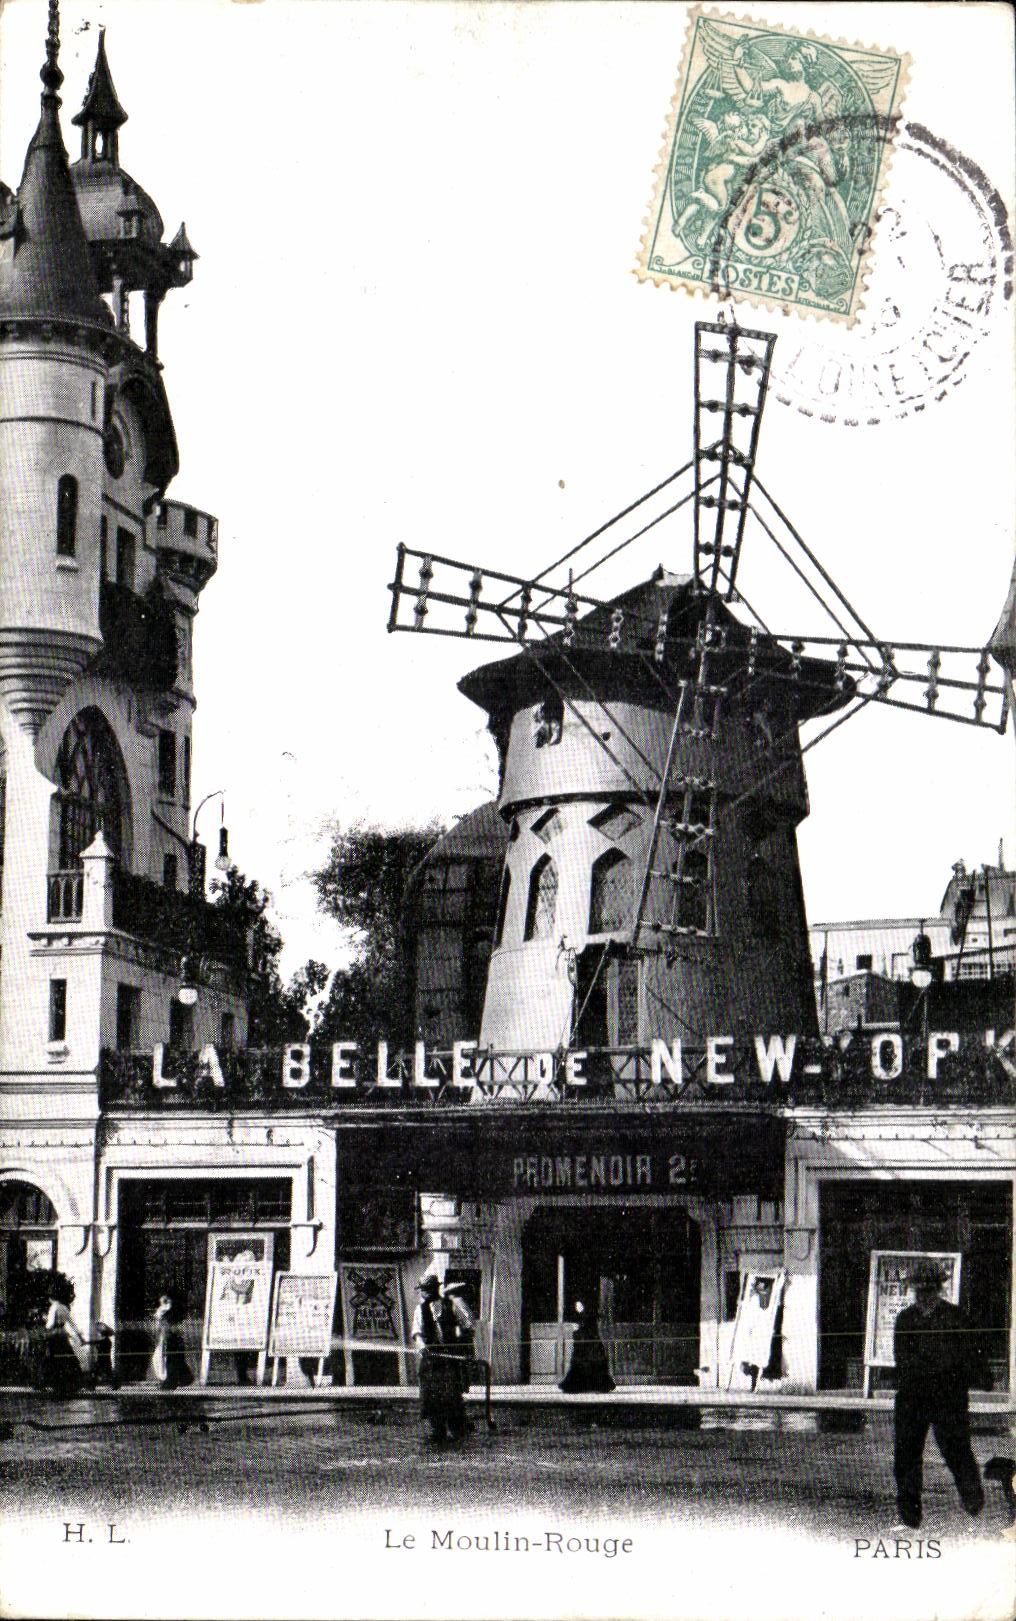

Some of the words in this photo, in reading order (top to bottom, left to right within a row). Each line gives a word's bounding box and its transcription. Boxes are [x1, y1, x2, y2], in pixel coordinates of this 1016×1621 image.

[706, 255, 796, 297] POSTES
[152, 1041, 227, 1088] LA
[282, 1039, 479, 1088] BELLE
[533, 1051, 589, 1087] DE
[513, 1154, 651, 1188] PROMENOIR
